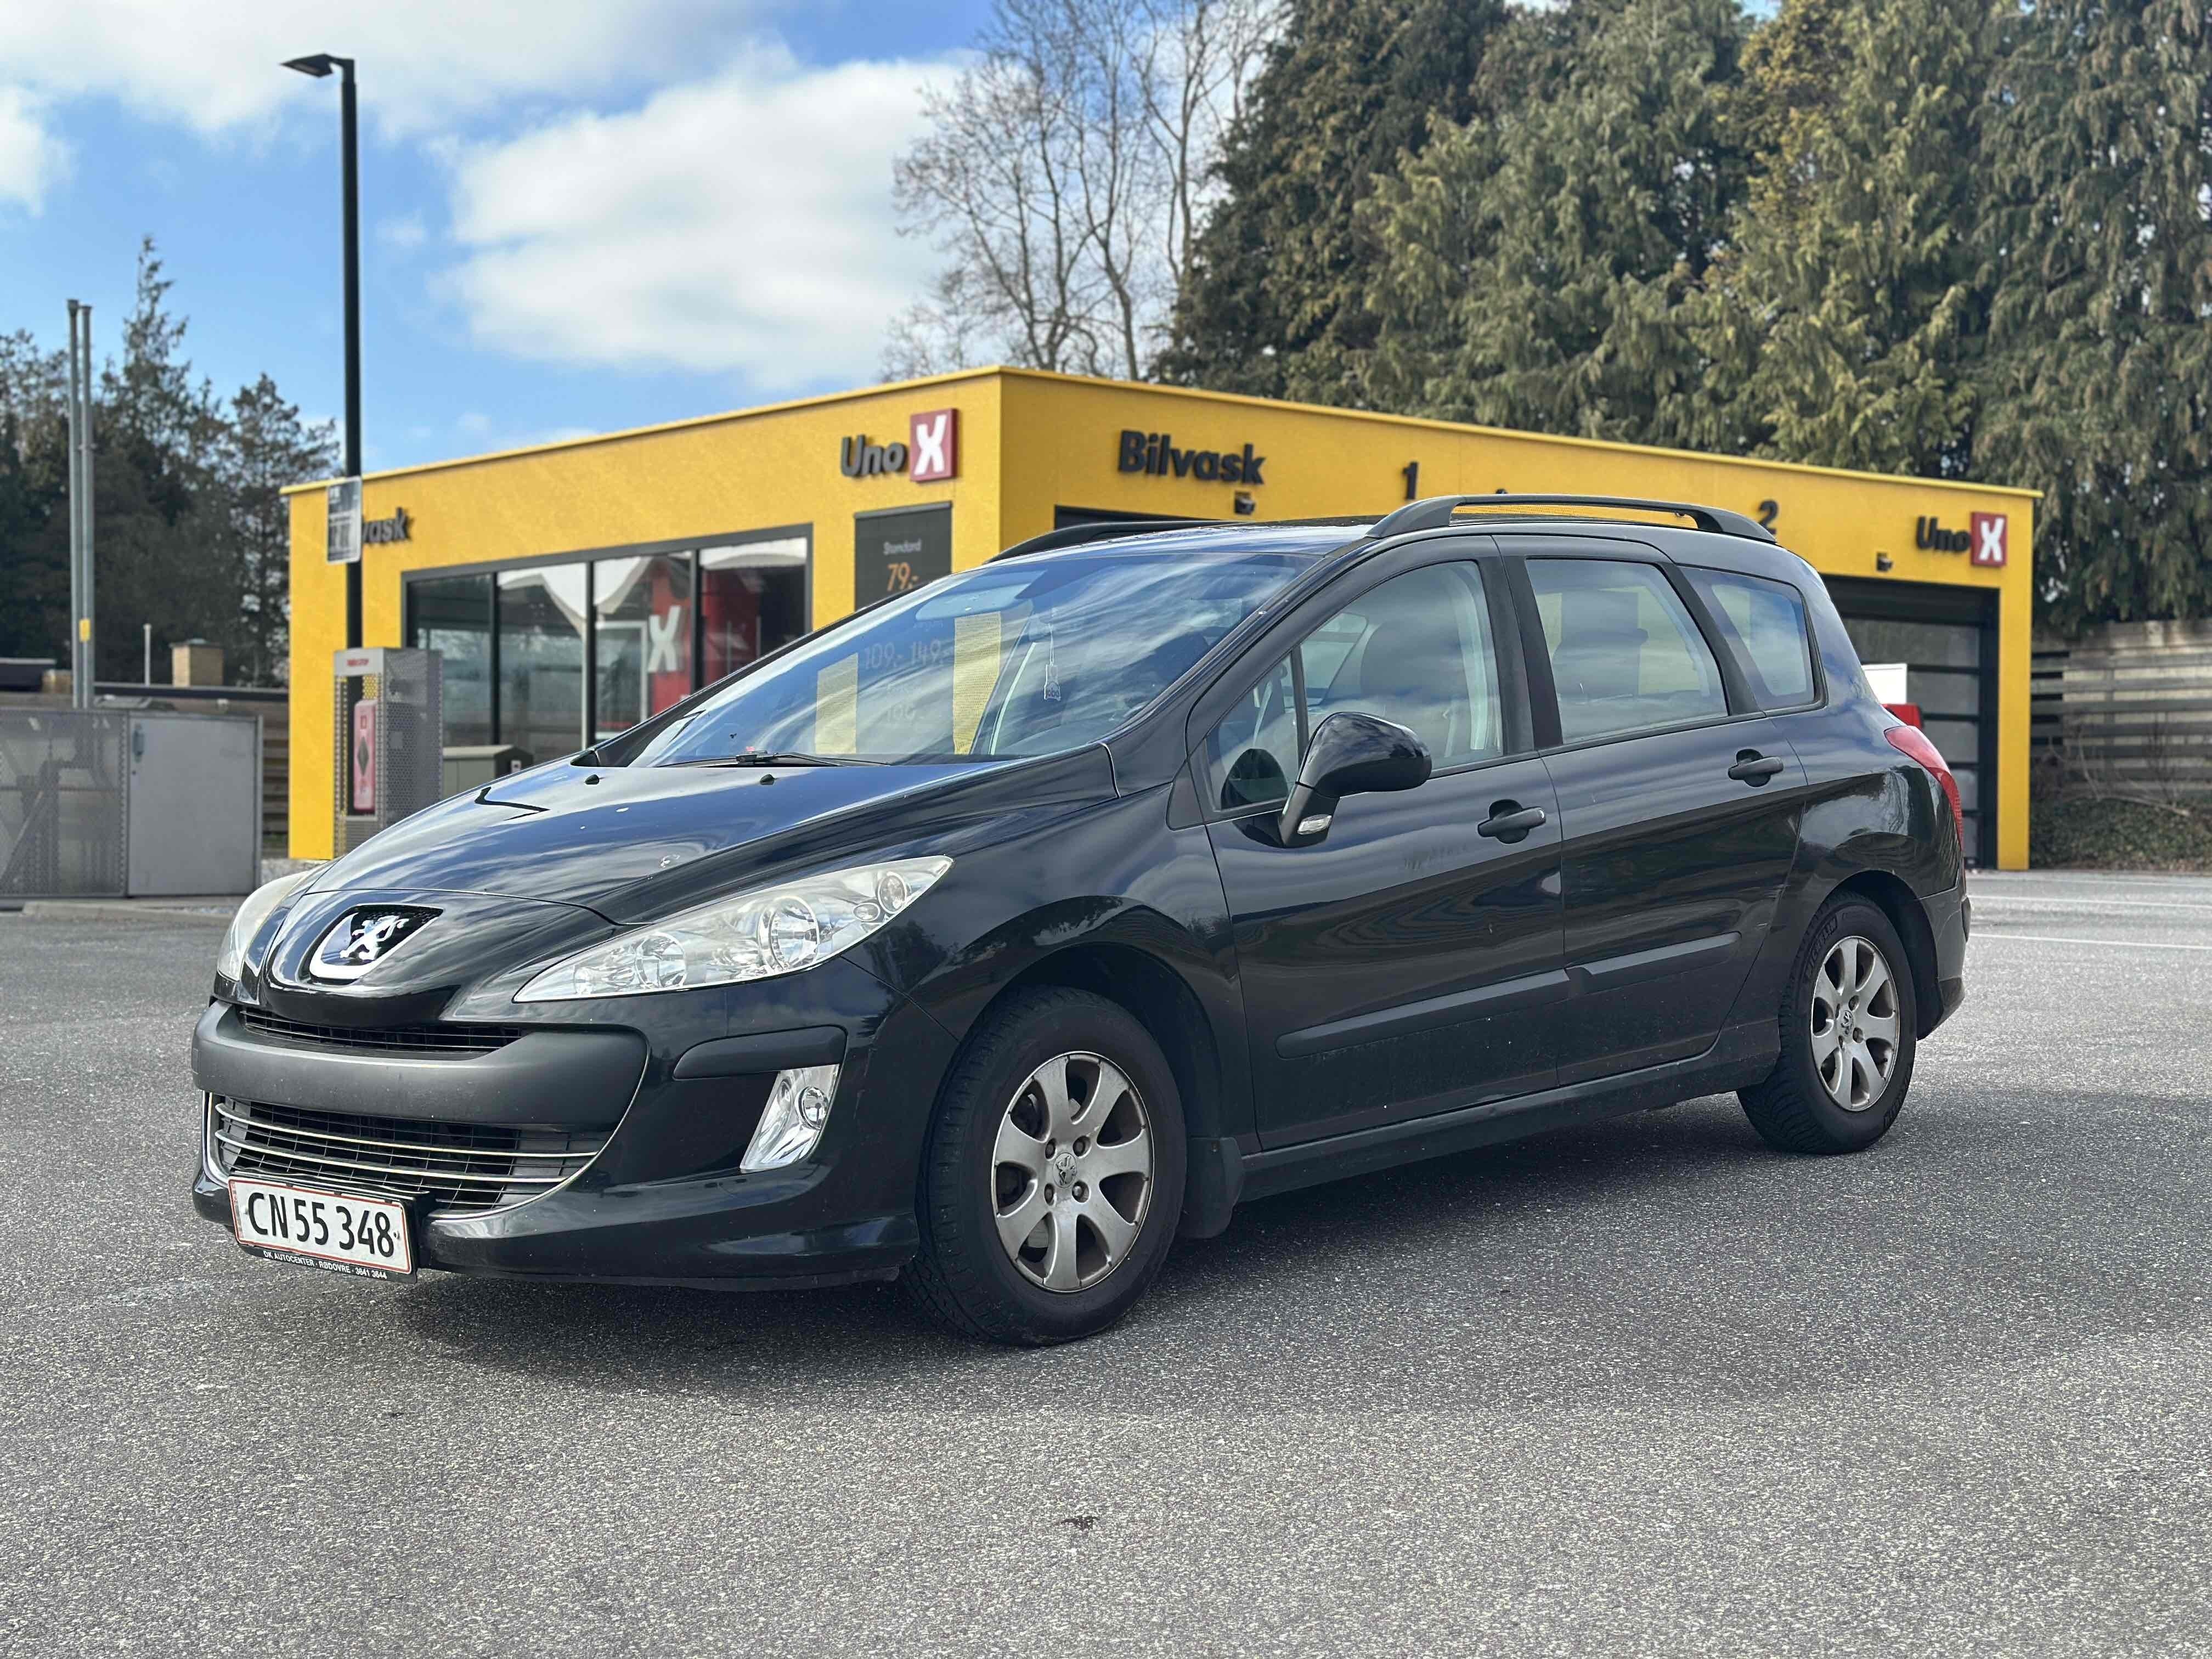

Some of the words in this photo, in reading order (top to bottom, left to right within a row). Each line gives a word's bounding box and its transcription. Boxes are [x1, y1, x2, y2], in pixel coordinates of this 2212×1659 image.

[840, 435, 907, 478] Uno
[913, 414, 947, 476] X
[1118, 430, 1266, 484] Bilvask
[1402, 461, 1419, 500] 1
[1757, 500, 1778, 535] 2
[1915, 516, 1971, 554] Uno
[1979, 518, 2005, 562] X
[647, 606, 681, 672] X
[247, 1192, 289, 1239] CN
[294, 1198, 329, 1245] 55
[336, 1205, 394, 1258] 348
[263, 1250, 273, 1259] DK
[274, 1253, 315, 1267] AUTOCENTER
[318, 1261, 351, 1273] RØDOVRE
